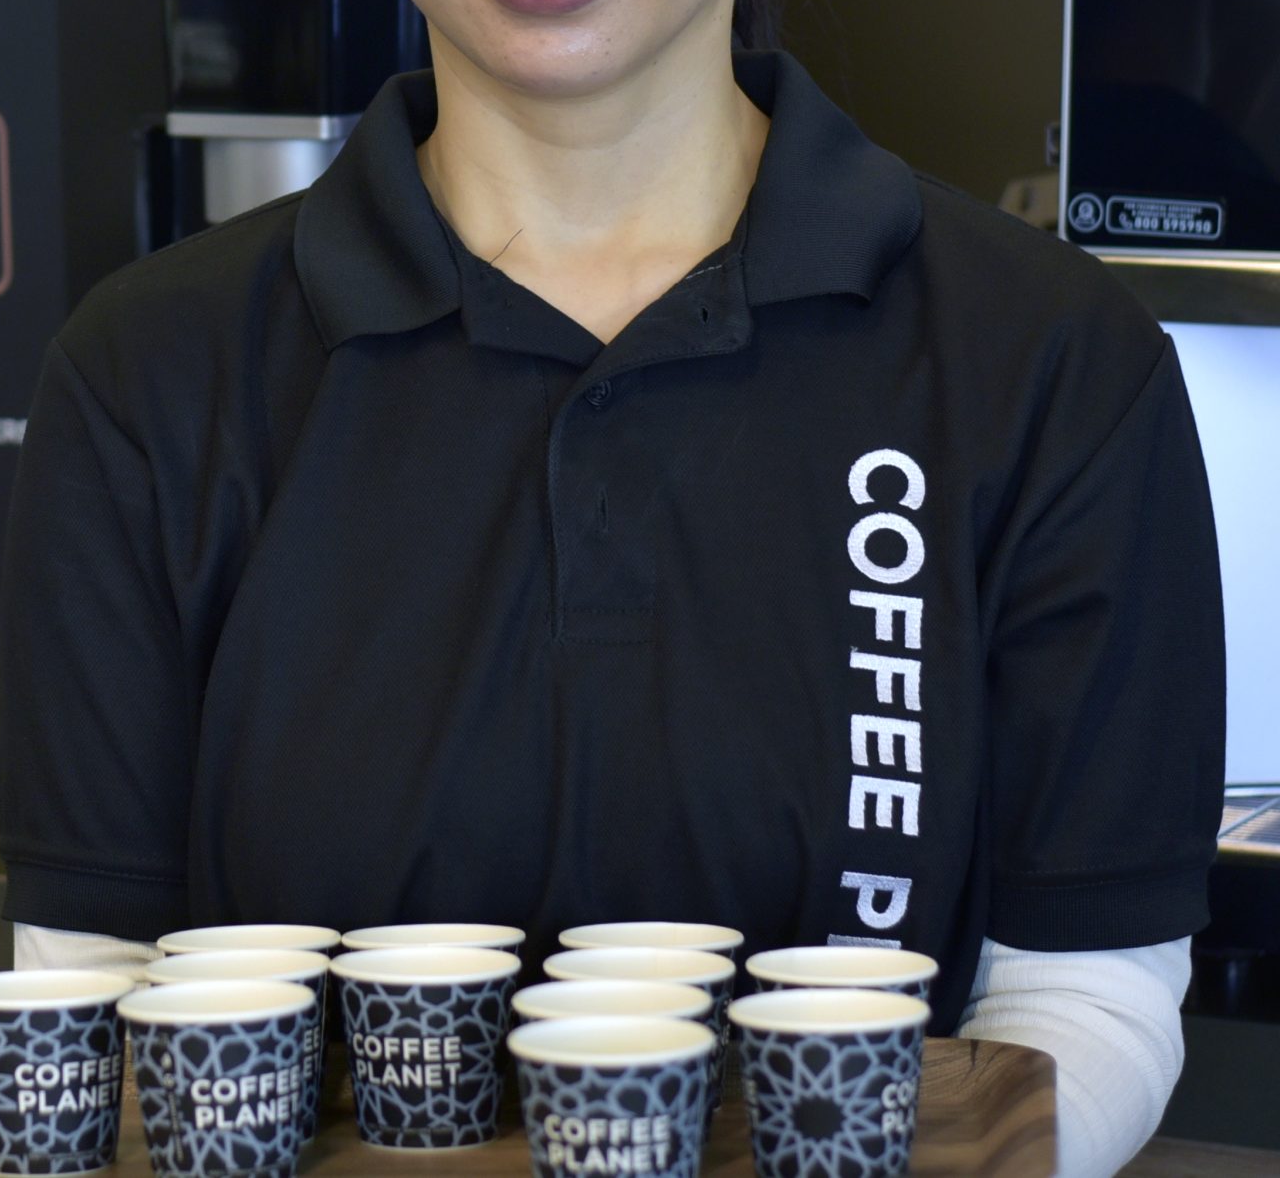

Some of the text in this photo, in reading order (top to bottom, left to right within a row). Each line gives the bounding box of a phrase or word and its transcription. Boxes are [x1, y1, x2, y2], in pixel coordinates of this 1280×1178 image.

[847, 449, 926, 836] COFFEE
[352, 1032, 461, 1061] COFFEE
[14, 1054, 120, 1089] COFFEE
[190, 1065, 300, 1104] COFFEE
[356, 1058, 461, 1088] PLANET
[18, 1080, 119, 1115] PLANET
[195, 1092, 300, 1129] PLANET
[543, 1114, 671, 1147] COFFEE
[547, 1141, 671, 1175] PLANET
